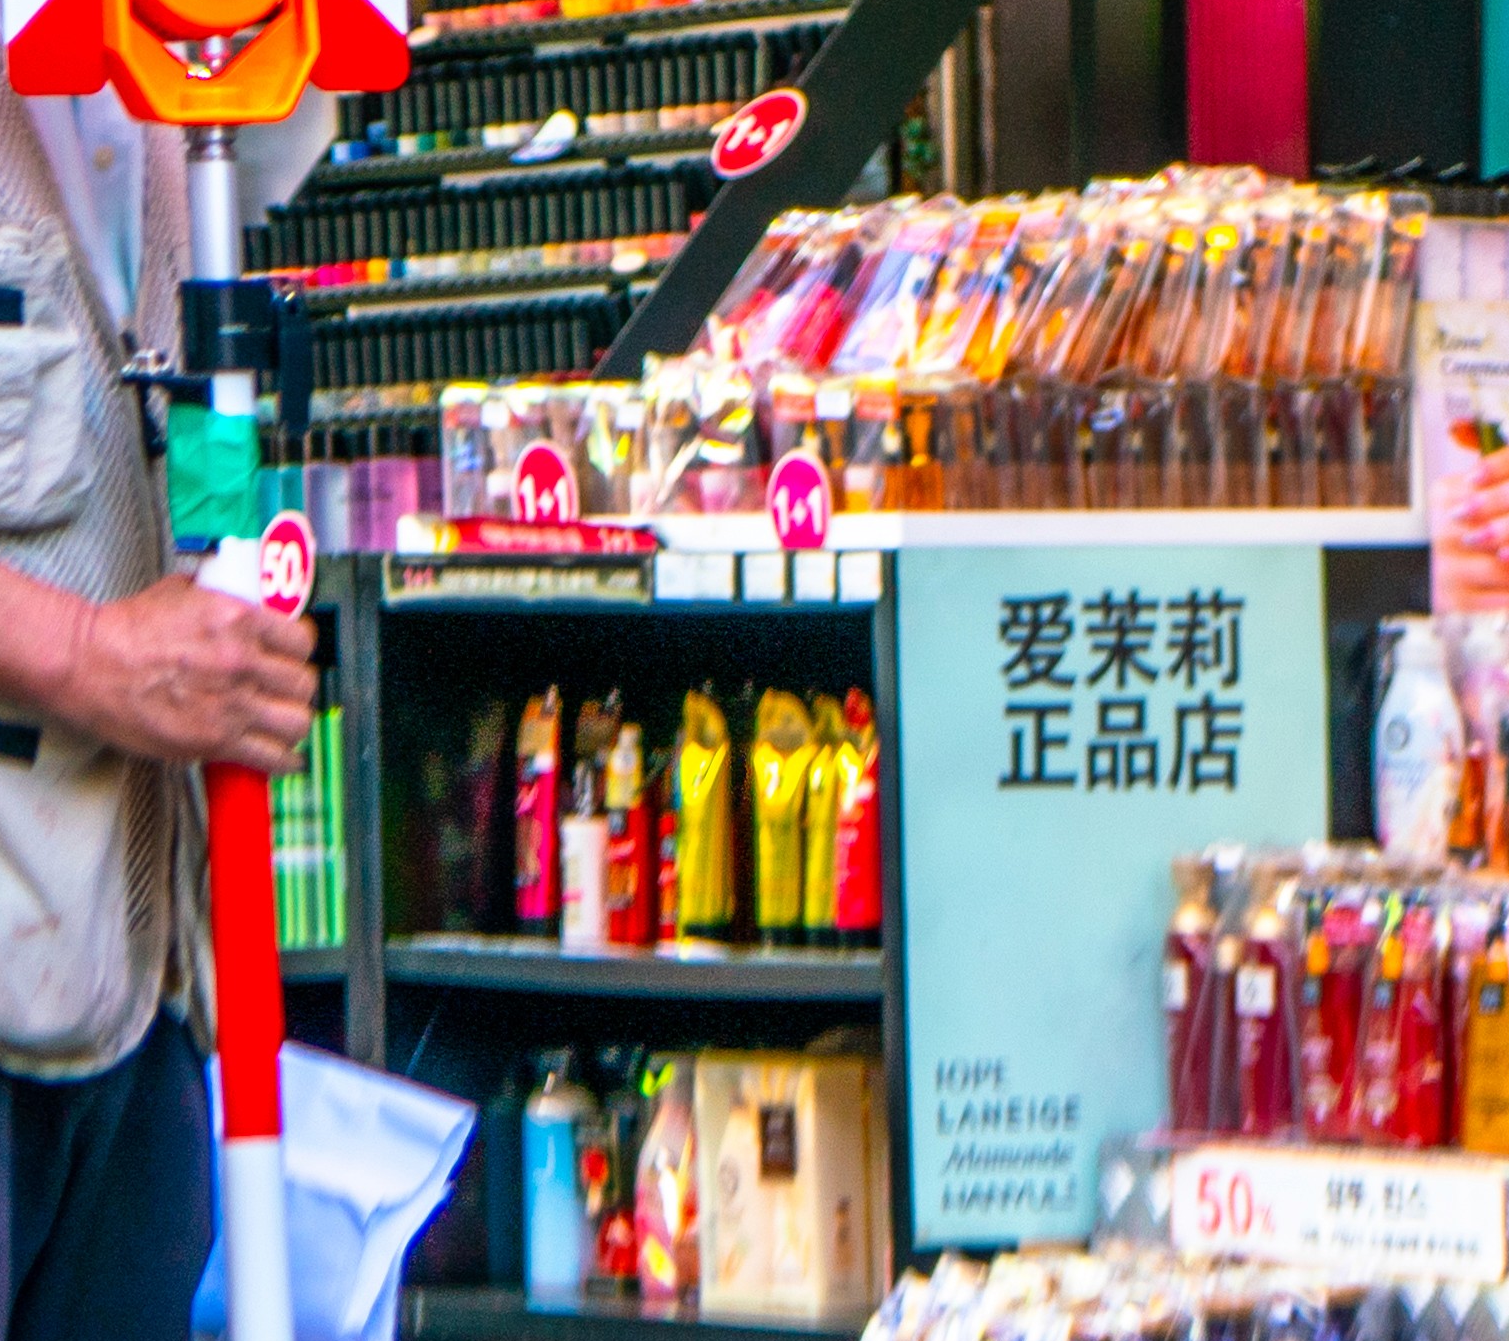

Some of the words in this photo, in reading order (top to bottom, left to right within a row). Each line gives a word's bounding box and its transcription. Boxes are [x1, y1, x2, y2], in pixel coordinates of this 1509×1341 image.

[724, 113, 790, 155] 1+1
[519, 474, 570, 523] 1+1
[774, 484, 823, 537] 1+1
[997, 588, 1246, 690] 爱茉莉
[997, 692, 1244, 793] 正品店
[936, 1092, 1082, 1135] LANEIGE
[1197, 1169, 1275, 1239] 50%
